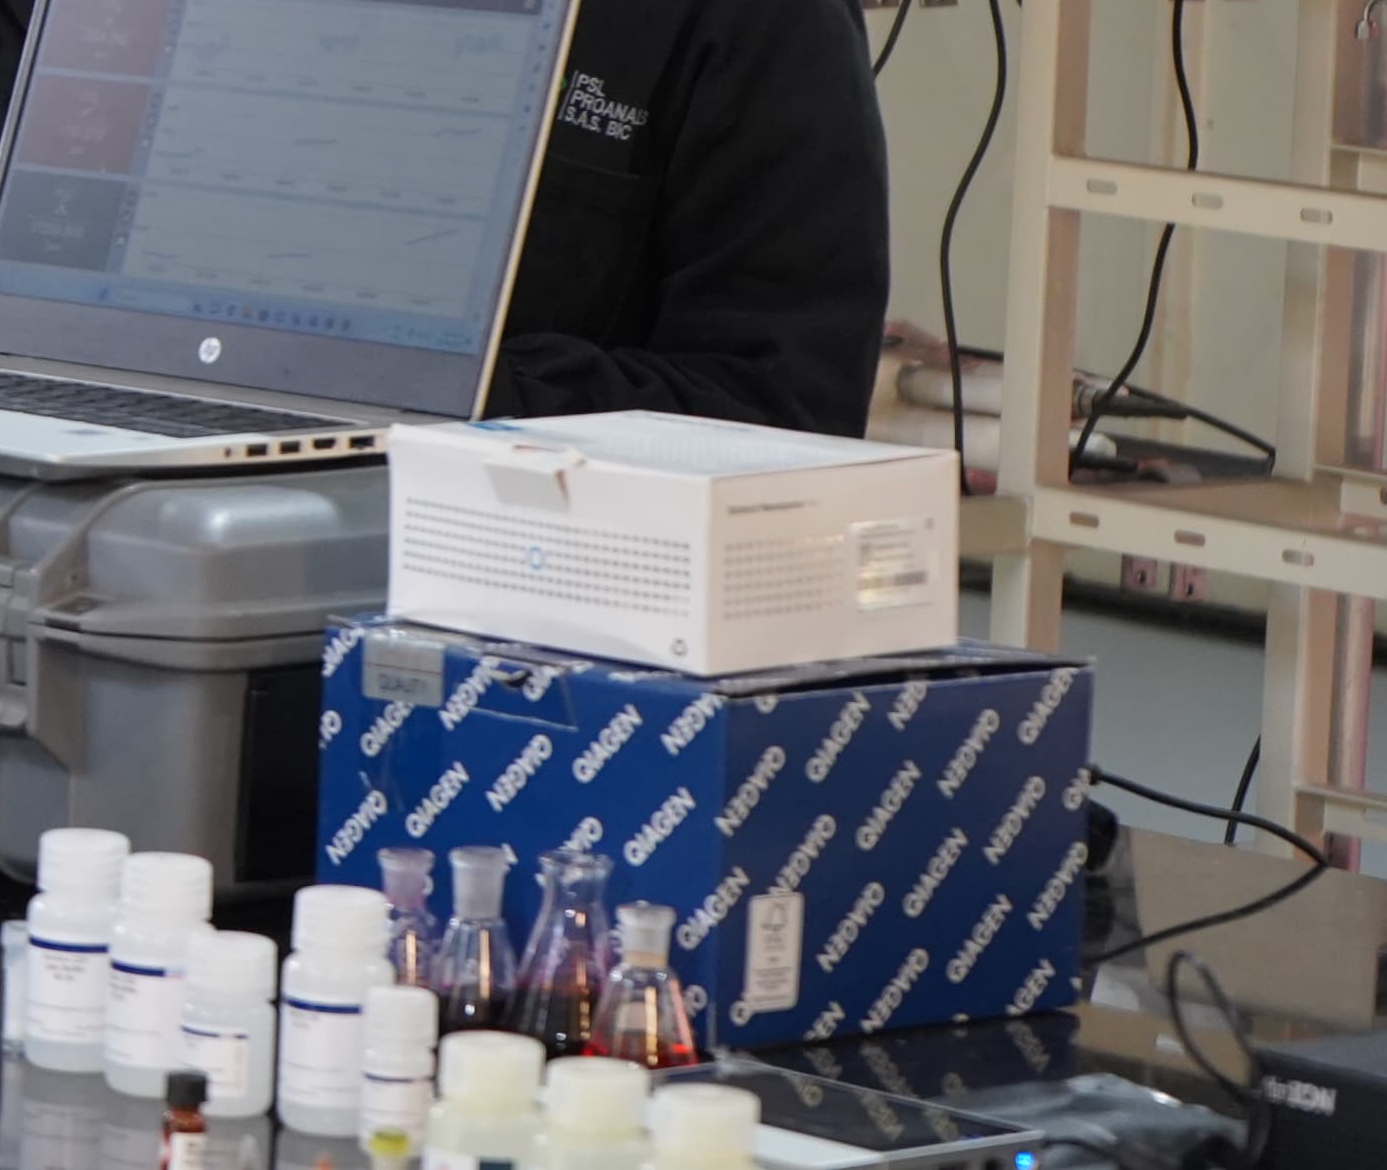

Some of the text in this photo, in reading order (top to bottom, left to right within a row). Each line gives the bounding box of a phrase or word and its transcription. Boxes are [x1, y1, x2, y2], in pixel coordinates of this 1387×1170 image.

[577, 73, 605, 97] PSL
[486, 734, 552, 811] QIAGEN
[573, 704, 643, 783] QIAGEN
[805, 691, 872, 783] QIAGEN
[938, 709, 1000, 797] QIAGEN
[326, 790, 387, 865] QIAGEN
[406, 762, 469, 838] QIAGEN
[624, 787, 695, 866] QIAGEN
[714, 746, 786, 836] QIAGEN
[857, 761, 921, 850] QIAGEN
[984, 776, 1046, 864] QIAGEN
[677, 867, 750, 949] QIAGEN
[903, 829, 967, 916] QIAGEN
[1027, 842, 1088, 929] QIAGEN
[817, 882, 884, 971] QIAGEN
[948, 895, 1011, 983] QIAGEN
